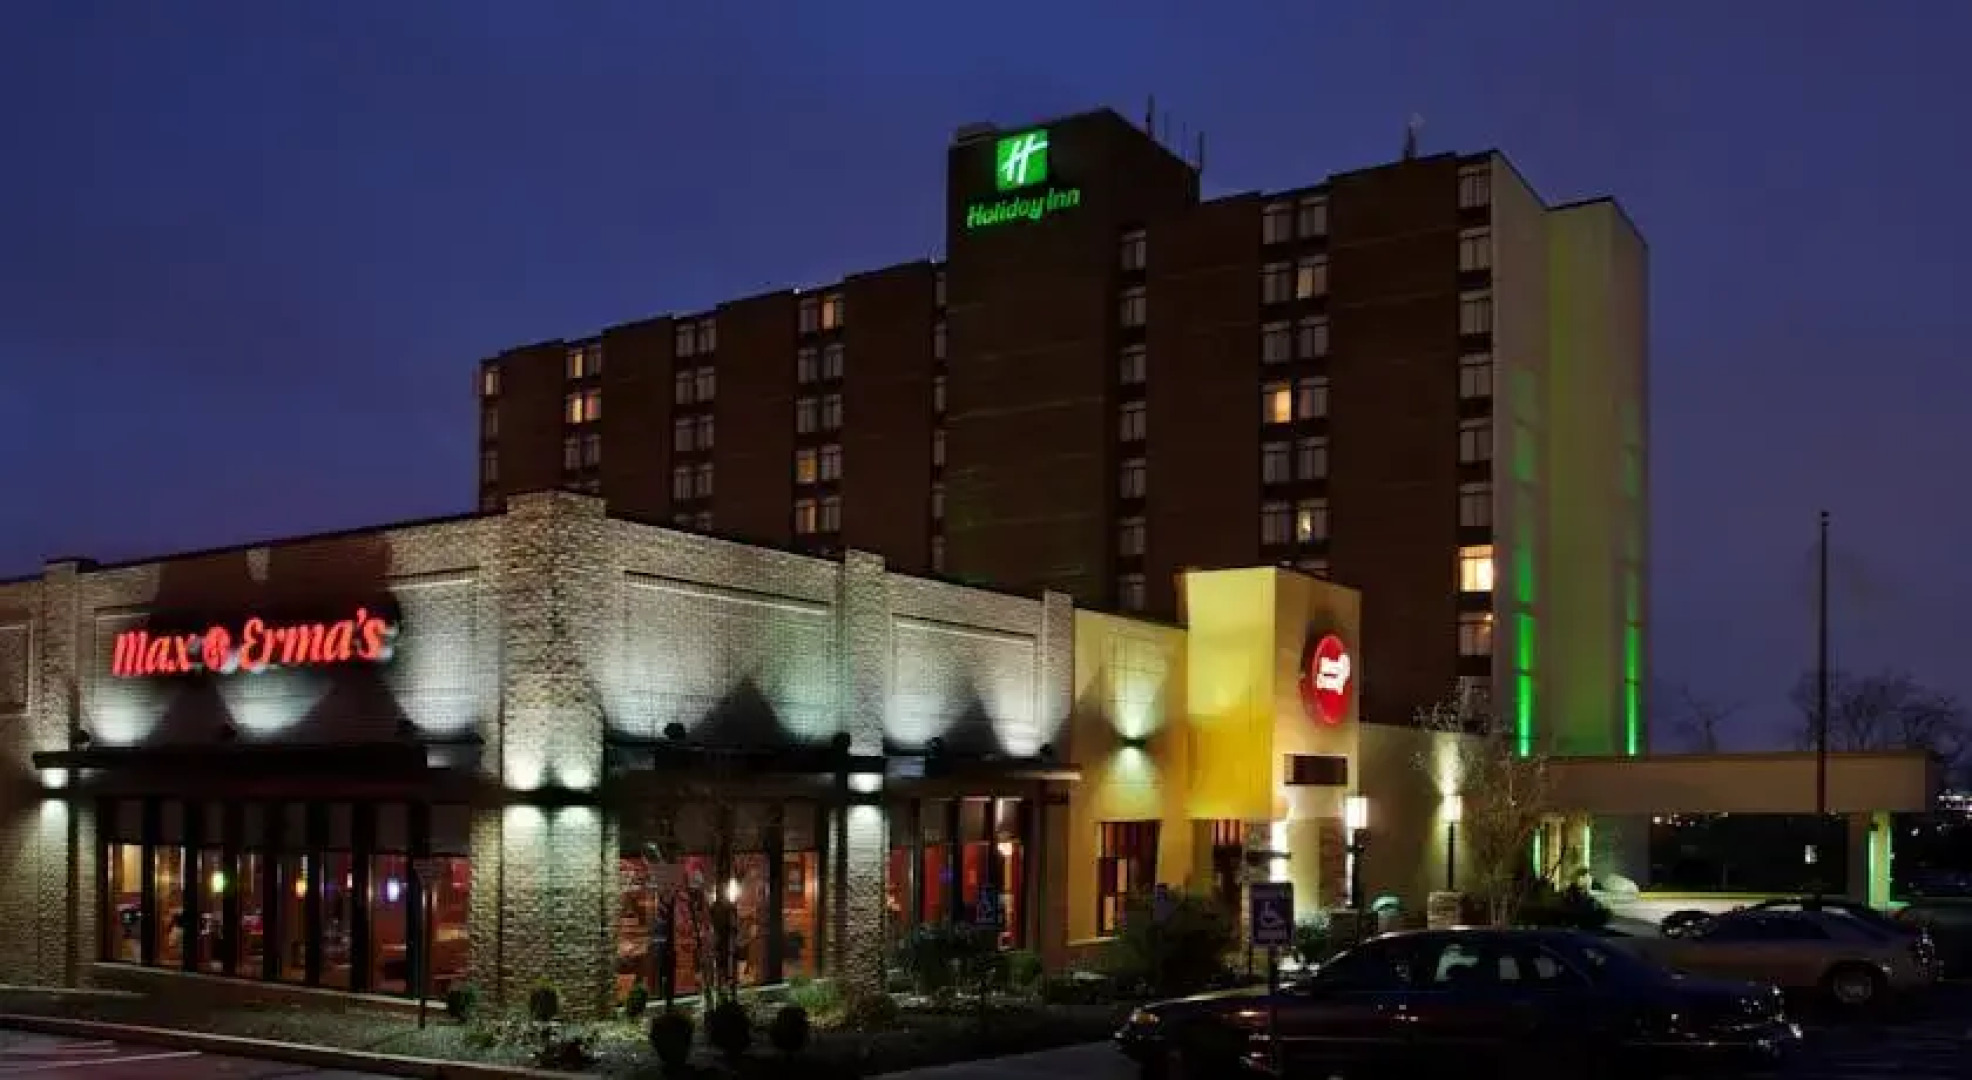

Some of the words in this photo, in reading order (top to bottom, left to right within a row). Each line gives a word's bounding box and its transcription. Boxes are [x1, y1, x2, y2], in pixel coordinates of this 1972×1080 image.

[967, 198, 1043, 228] Holiday
[1047, 188, 1080, 210] Inn
[112, 630, 195, 676] Max
[239, 607, 388, 670] Erma's
